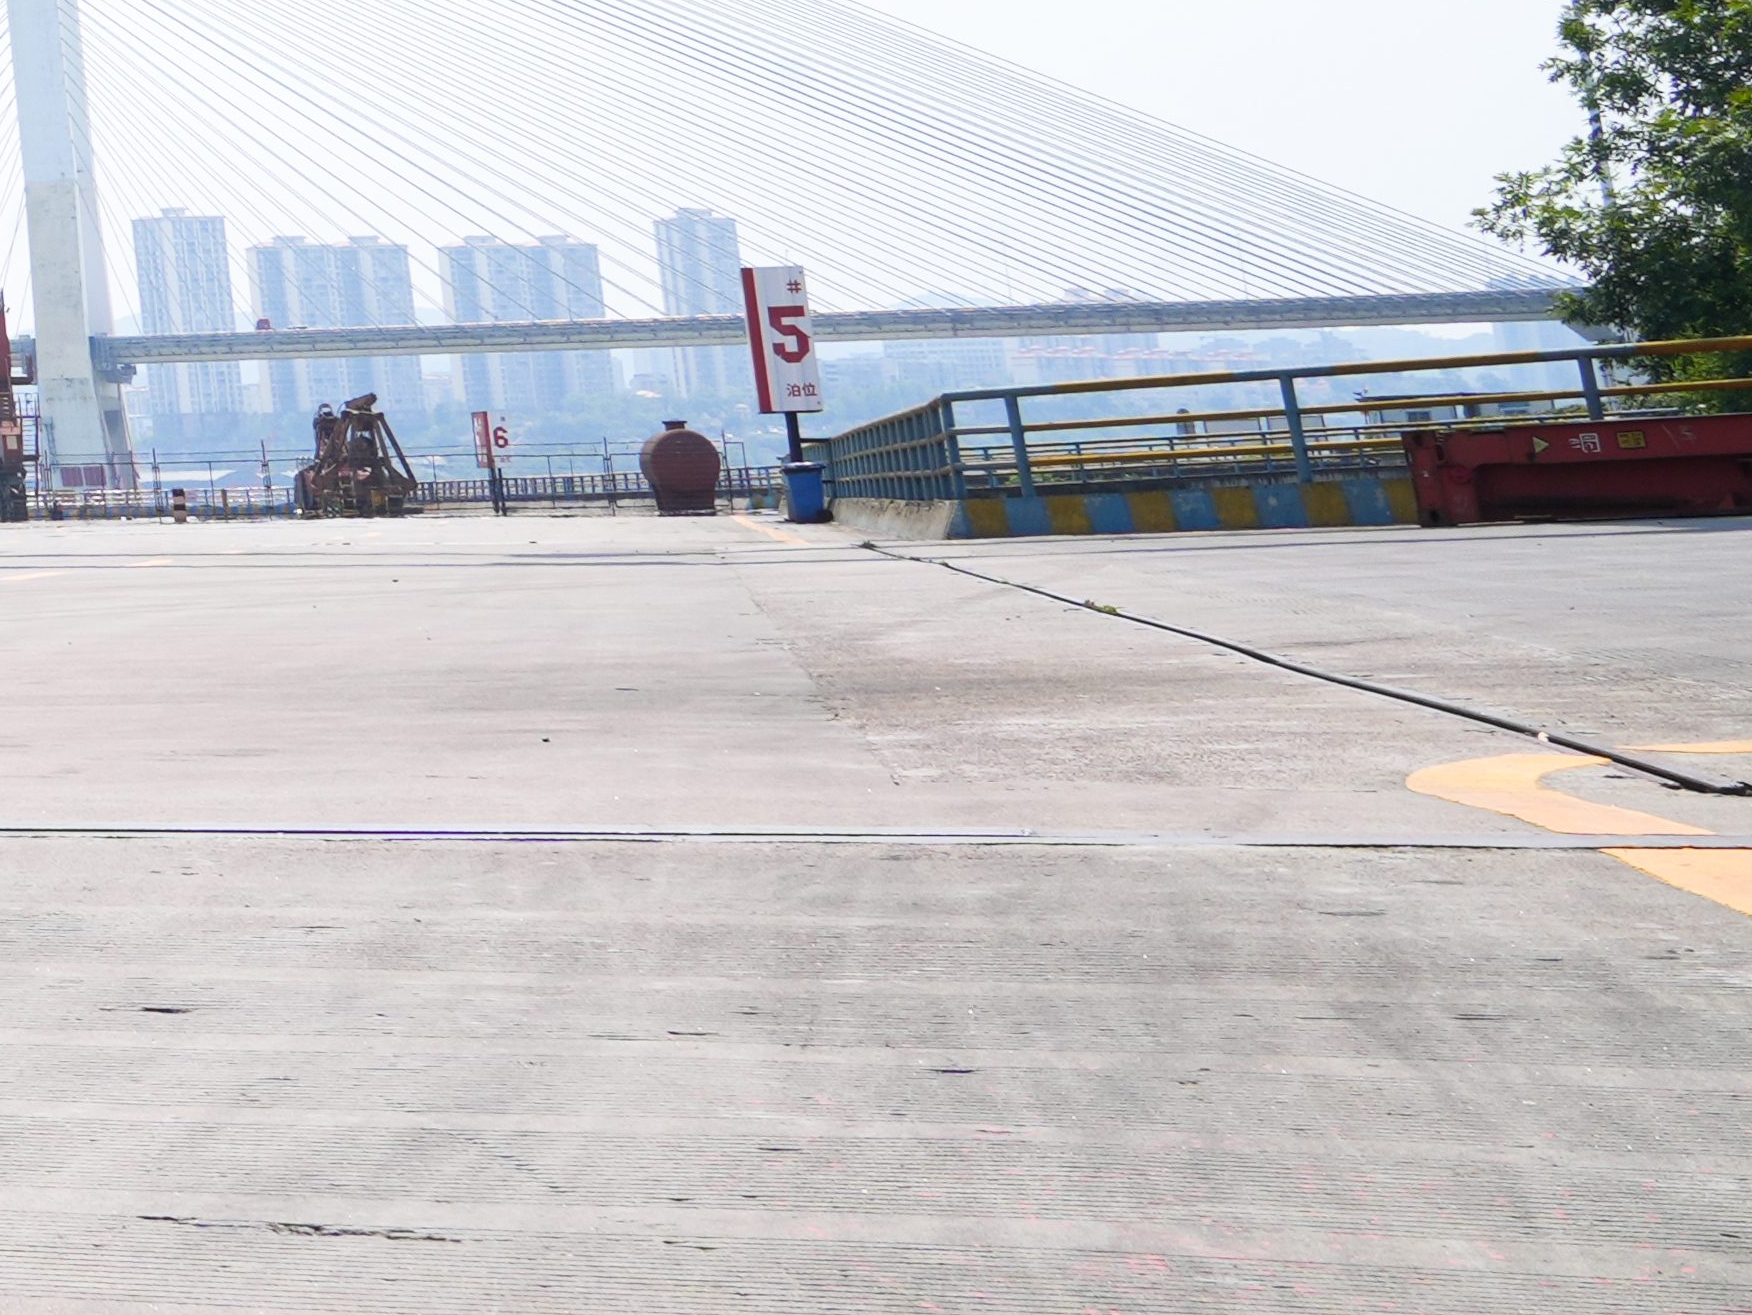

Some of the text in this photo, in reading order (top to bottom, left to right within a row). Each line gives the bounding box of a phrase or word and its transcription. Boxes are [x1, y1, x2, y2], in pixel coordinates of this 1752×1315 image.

[768, 305, 810, 363] 5
[786, 383, 818, 397] 泊位
[493, 426, 509, 449] 6
